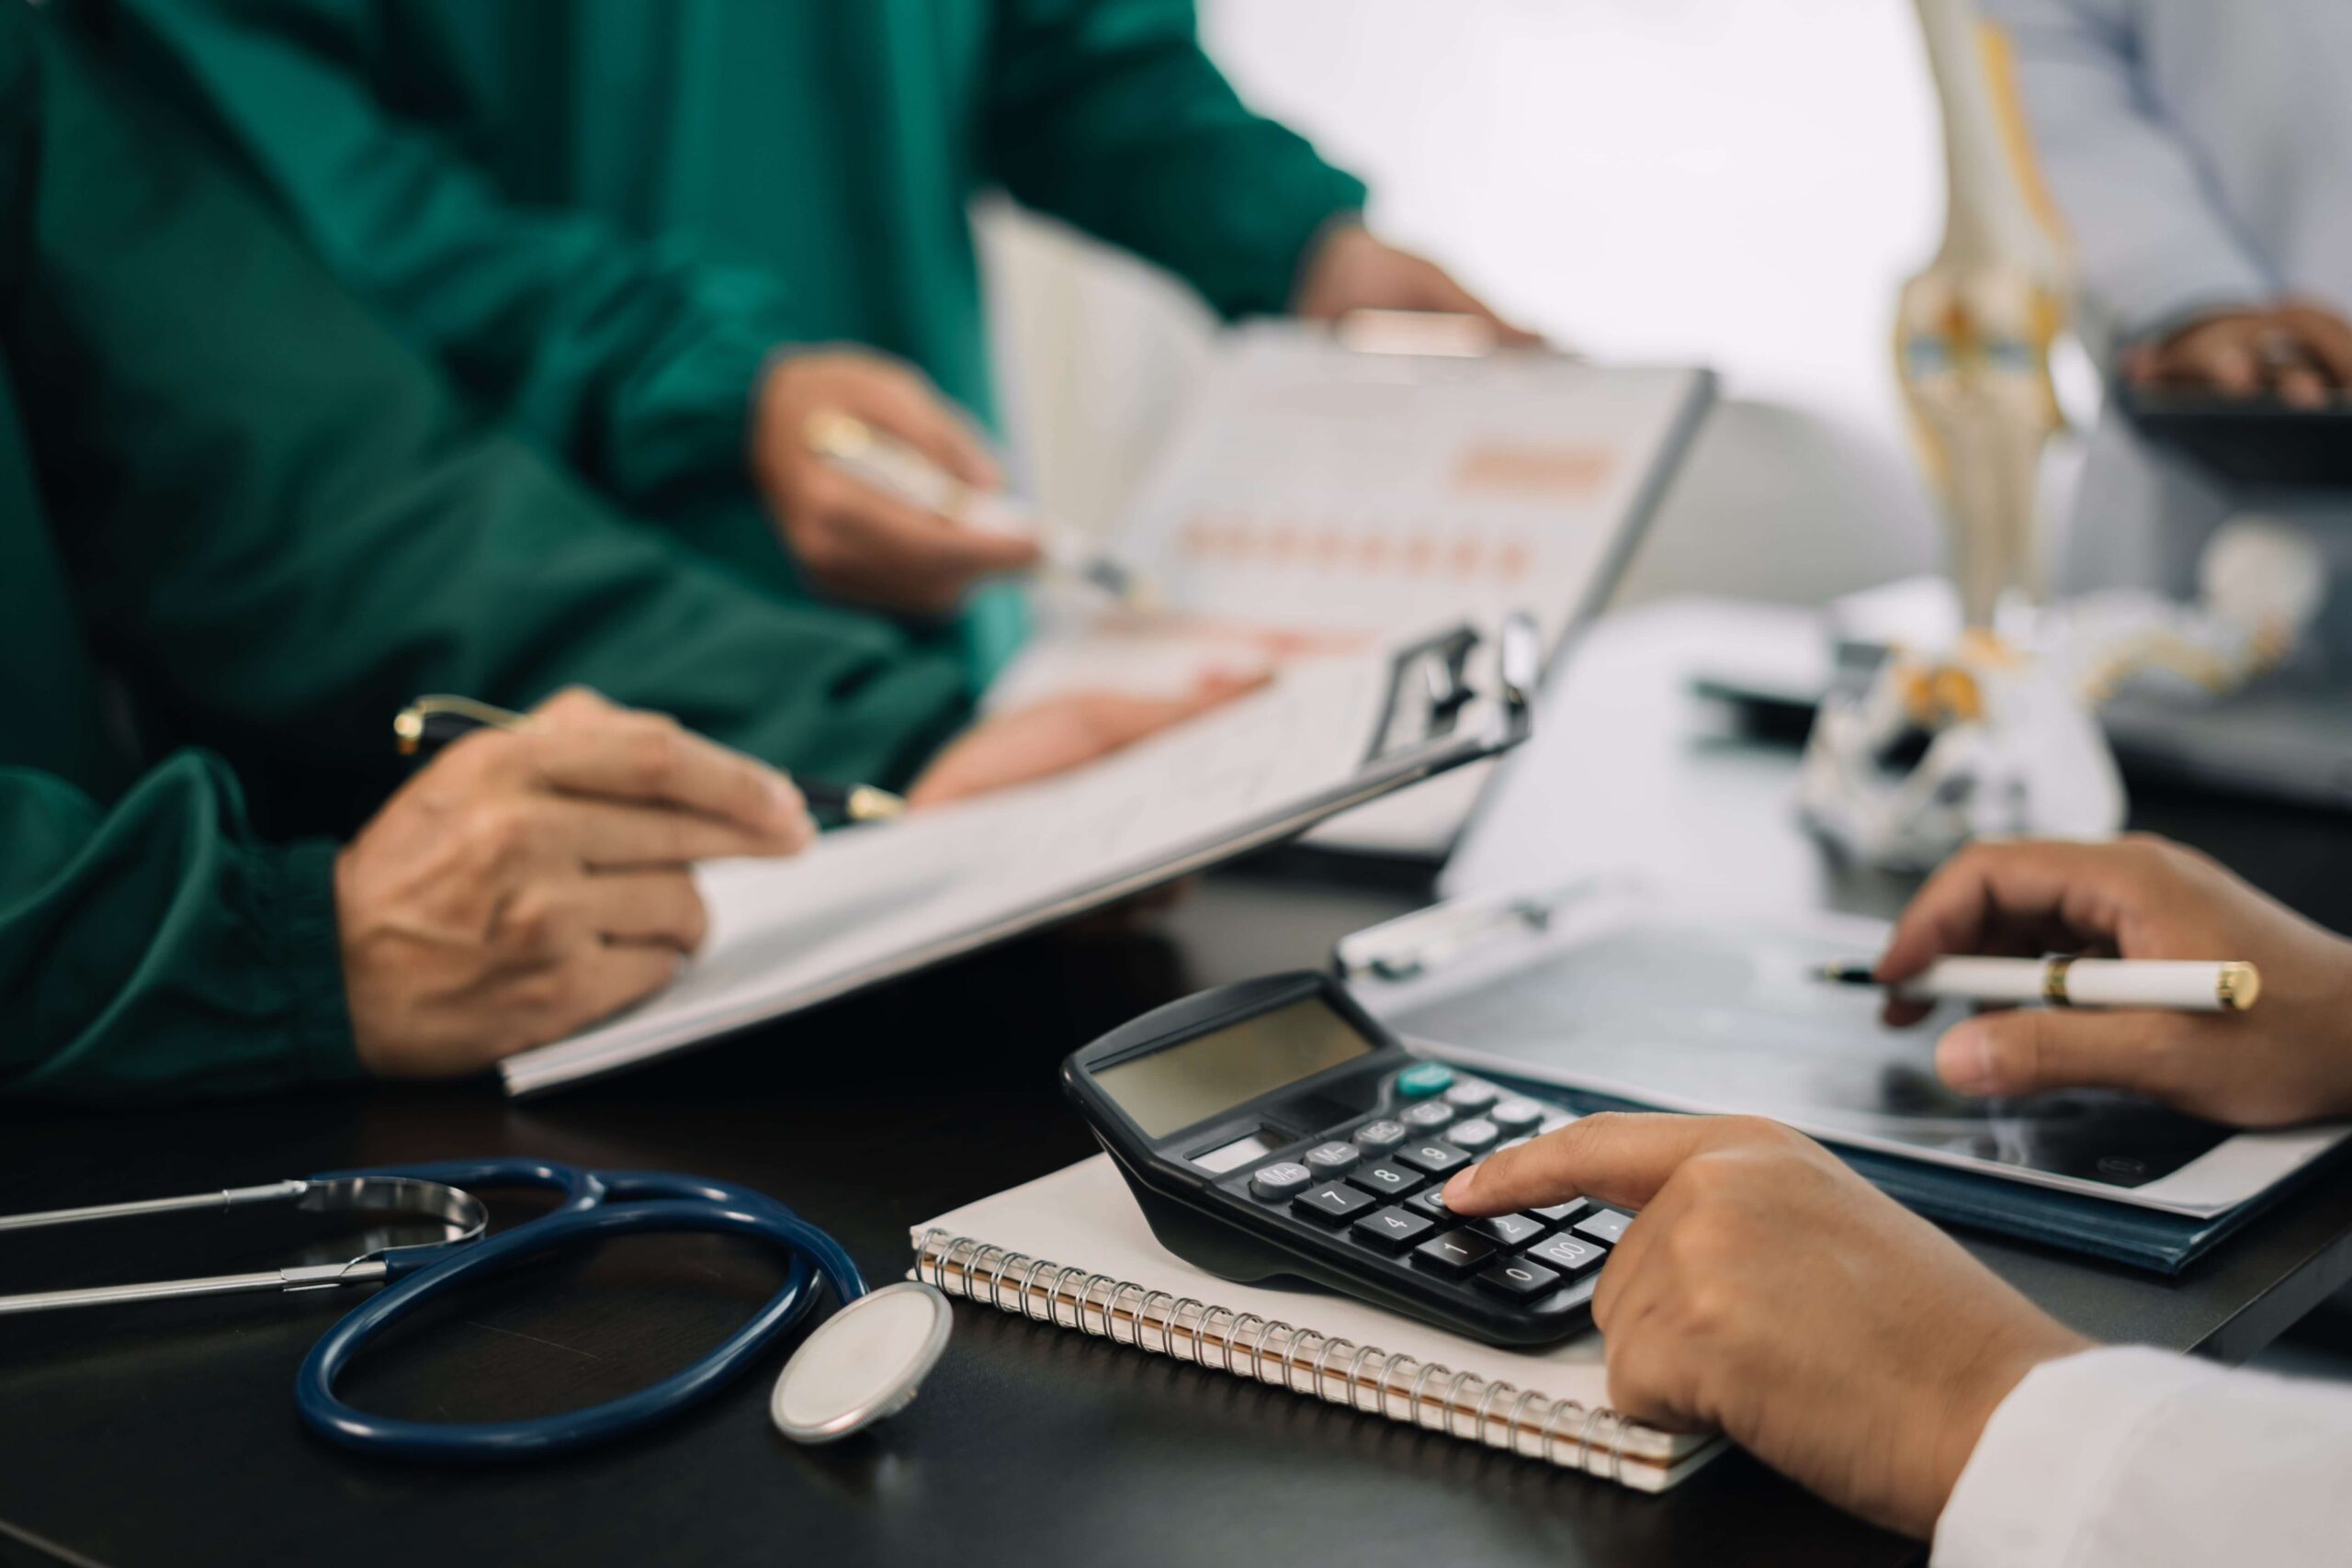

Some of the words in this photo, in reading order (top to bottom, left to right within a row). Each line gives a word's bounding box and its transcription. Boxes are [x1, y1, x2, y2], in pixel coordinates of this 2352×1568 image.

[1421, 1147, 1448, 1160] 9
[1263, 1167, 1299, 1183] M+
[1374, 1169, 1401, 1182] 8
[1321, 1190, 1346, 1205] 7
[1384, 1216, 1408, 1228] 4
[1495, 1220, 1522, 1235] 2
[1443, 1242, 1468, 1255] 1
[1548, 1241, 1586, 1260] 00
[1505, 1268, 1533, 1281] 0
